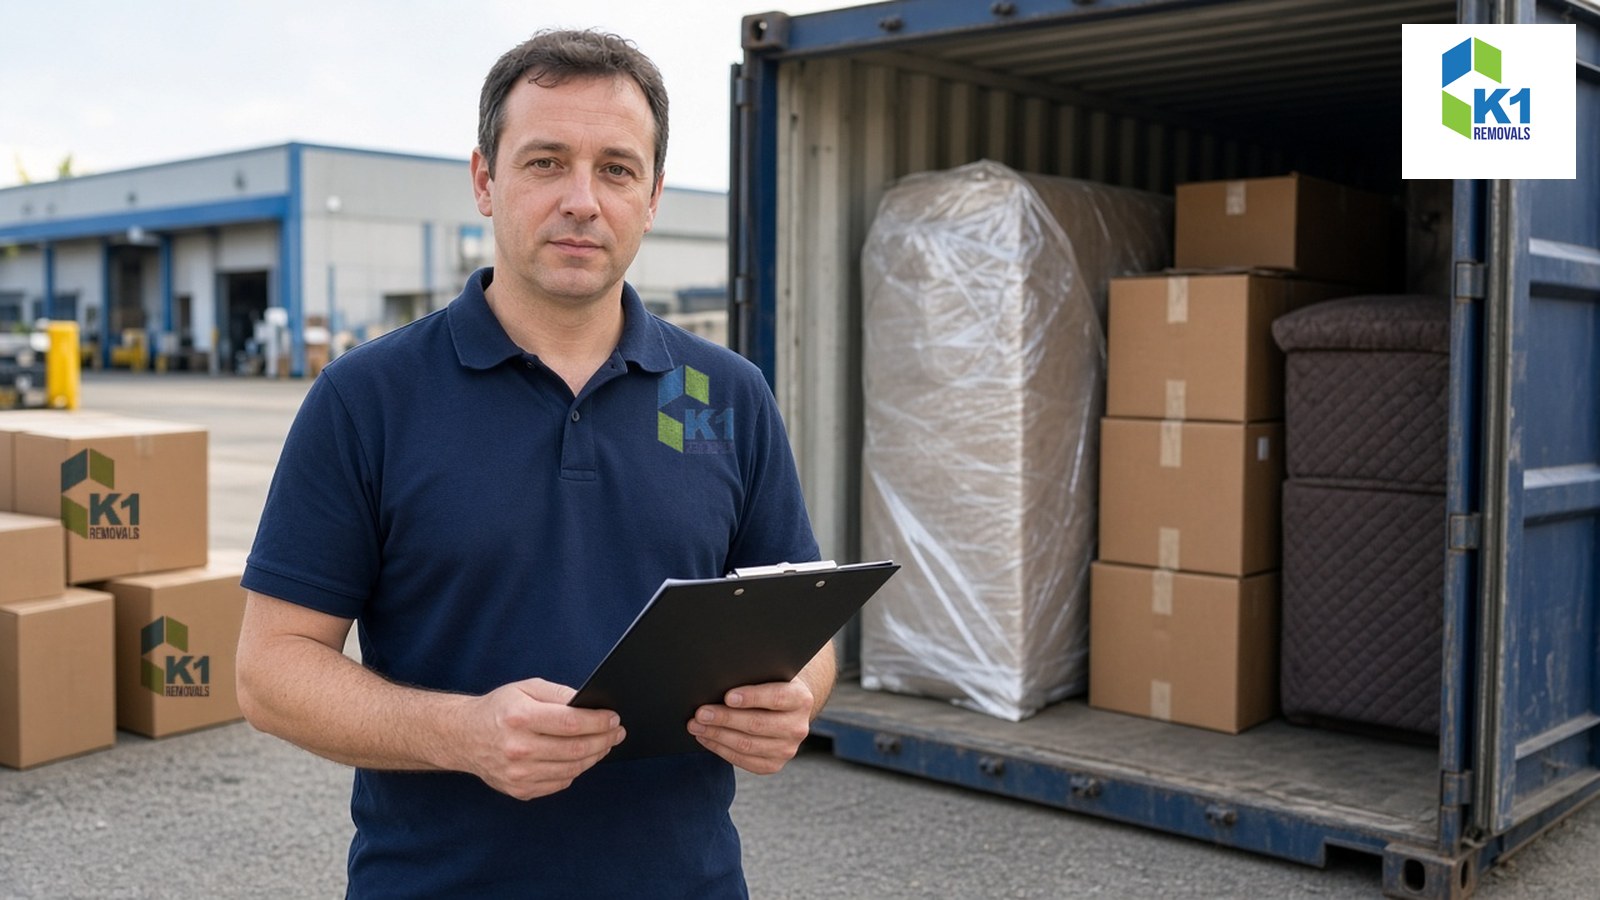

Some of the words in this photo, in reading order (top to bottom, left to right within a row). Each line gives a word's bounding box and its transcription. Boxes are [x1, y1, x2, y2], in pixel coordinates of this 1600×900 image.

[685, 408, 734, 440] K1
[90, 493, 139, 525] K1
[90, 527, 139, 539] REMOVALS
[166, 656, 209, 684] K1
[166, 686, 209, 697] REMOVALS
